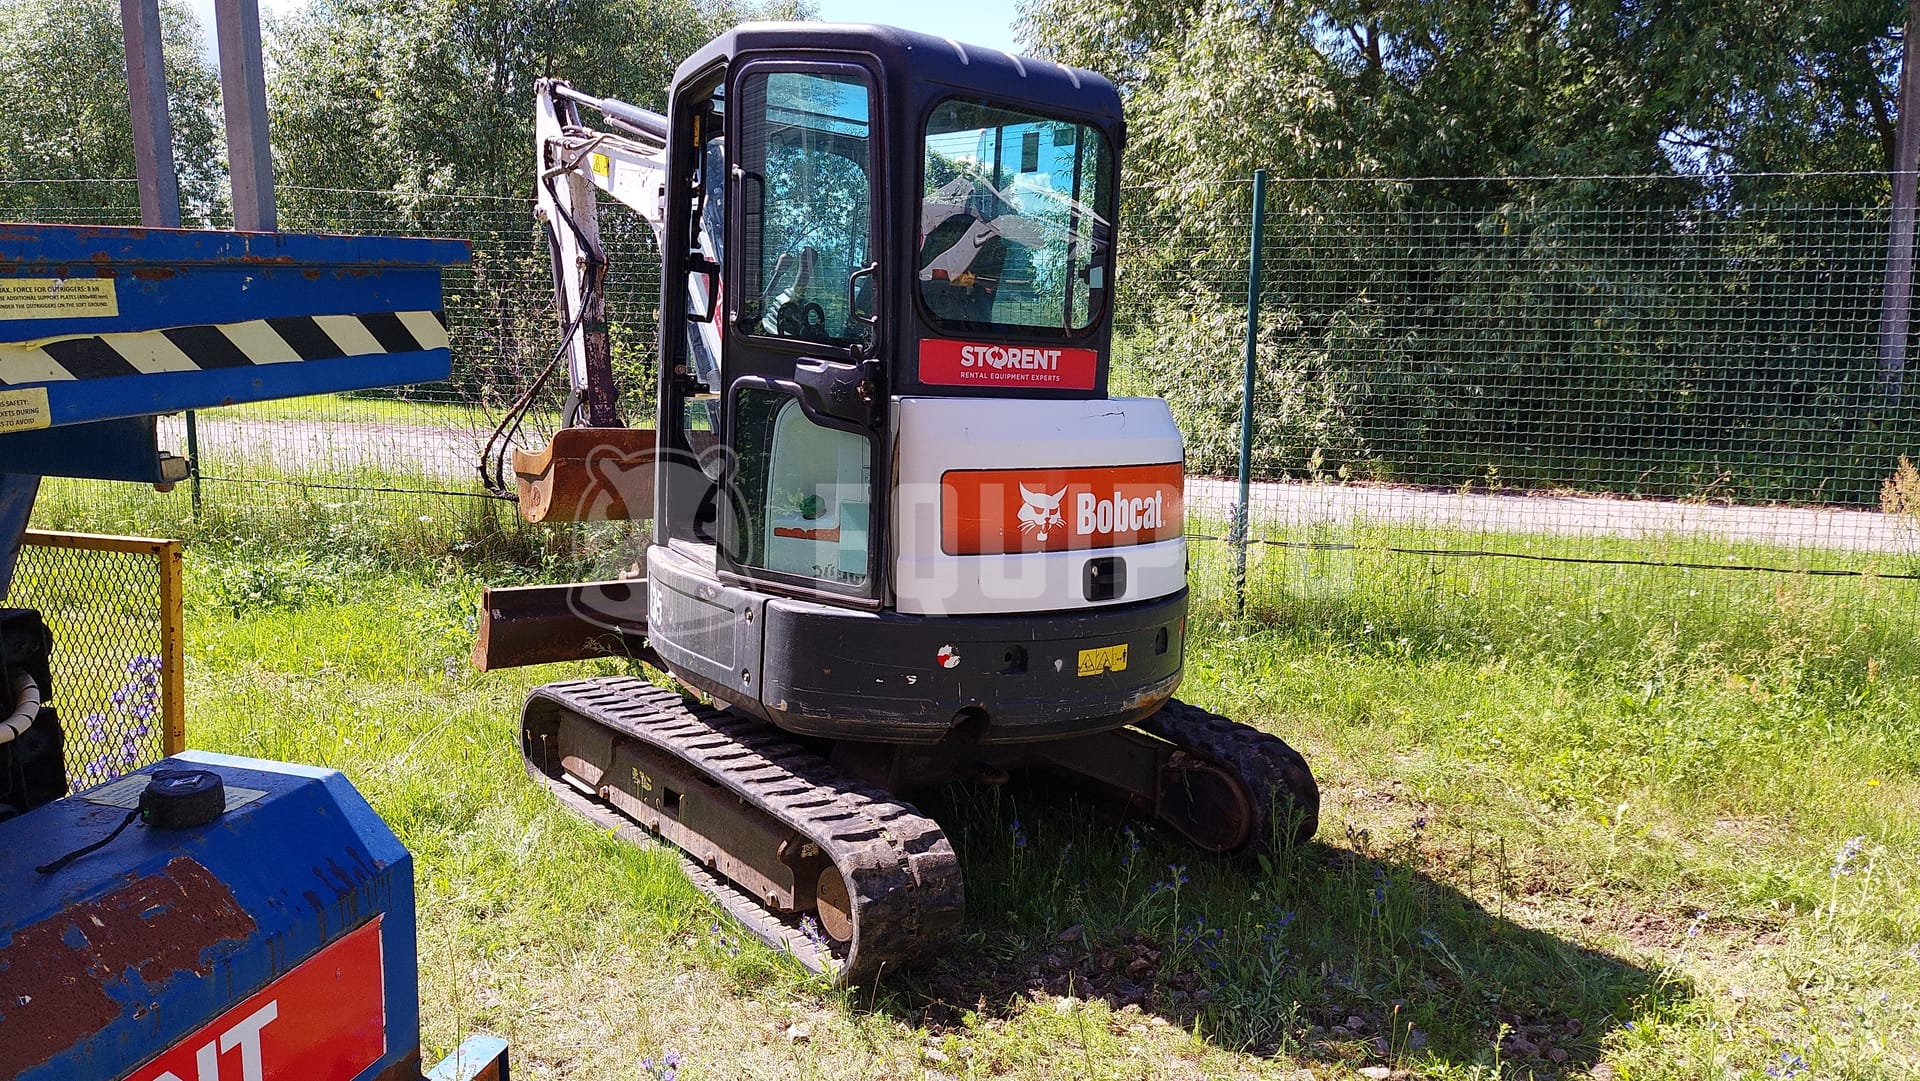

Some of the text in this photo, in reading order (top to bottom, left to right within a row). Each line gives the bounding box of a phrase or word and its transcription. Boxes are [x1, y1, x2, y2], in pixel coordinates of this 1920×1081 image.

[960, 345, 1061, 370] STORENT
[960, 371, 1060, 382] RENTAL EQUIPMENT EXPERTS
[1077, 489, 1162, 535] Bobcat
